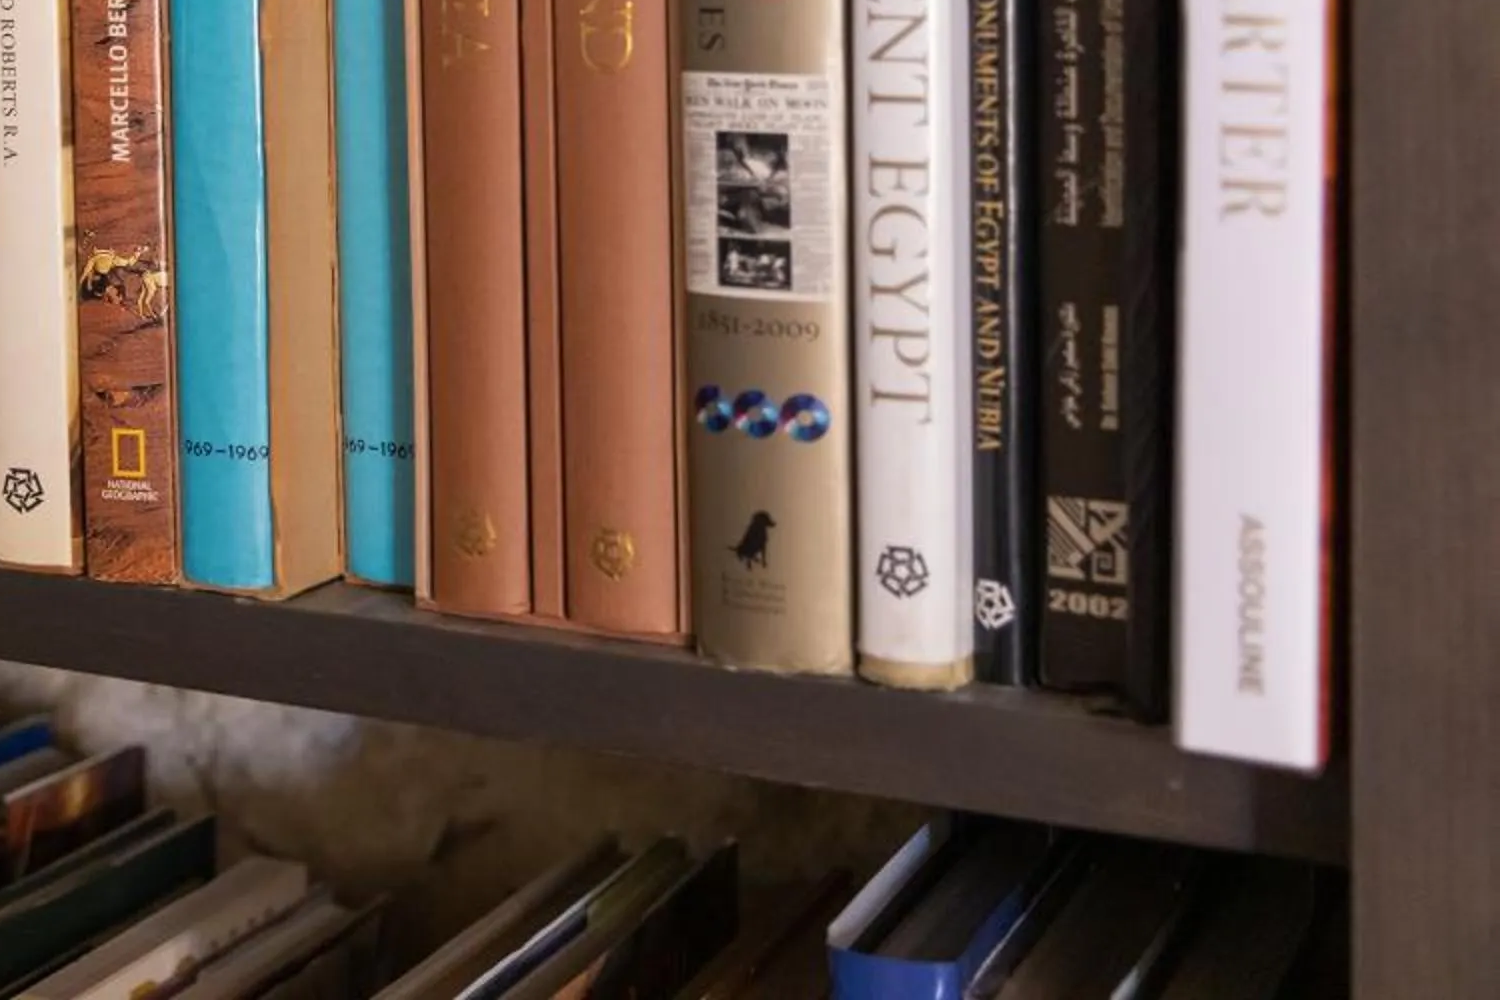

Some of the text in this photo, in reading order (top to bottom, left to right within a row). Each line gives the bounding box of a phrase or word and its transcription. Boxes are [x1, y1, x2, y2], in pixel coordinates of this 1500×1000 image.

[1, 124, 19, 168] R.A.
[109, 48, 130, 163] MARCELLO
[975, 152, 1000, 192] OF
[975, 200, 1004, 290] EGYPT
[865, 153, 935, 426] EGYPT
[976, 299, 1000, 359] AND
[976, 365, 1007, 451] NUBIA
[1047, 588, 1128, 621] 2002
[1235, 513, 1267, 701] ASSOULINE
